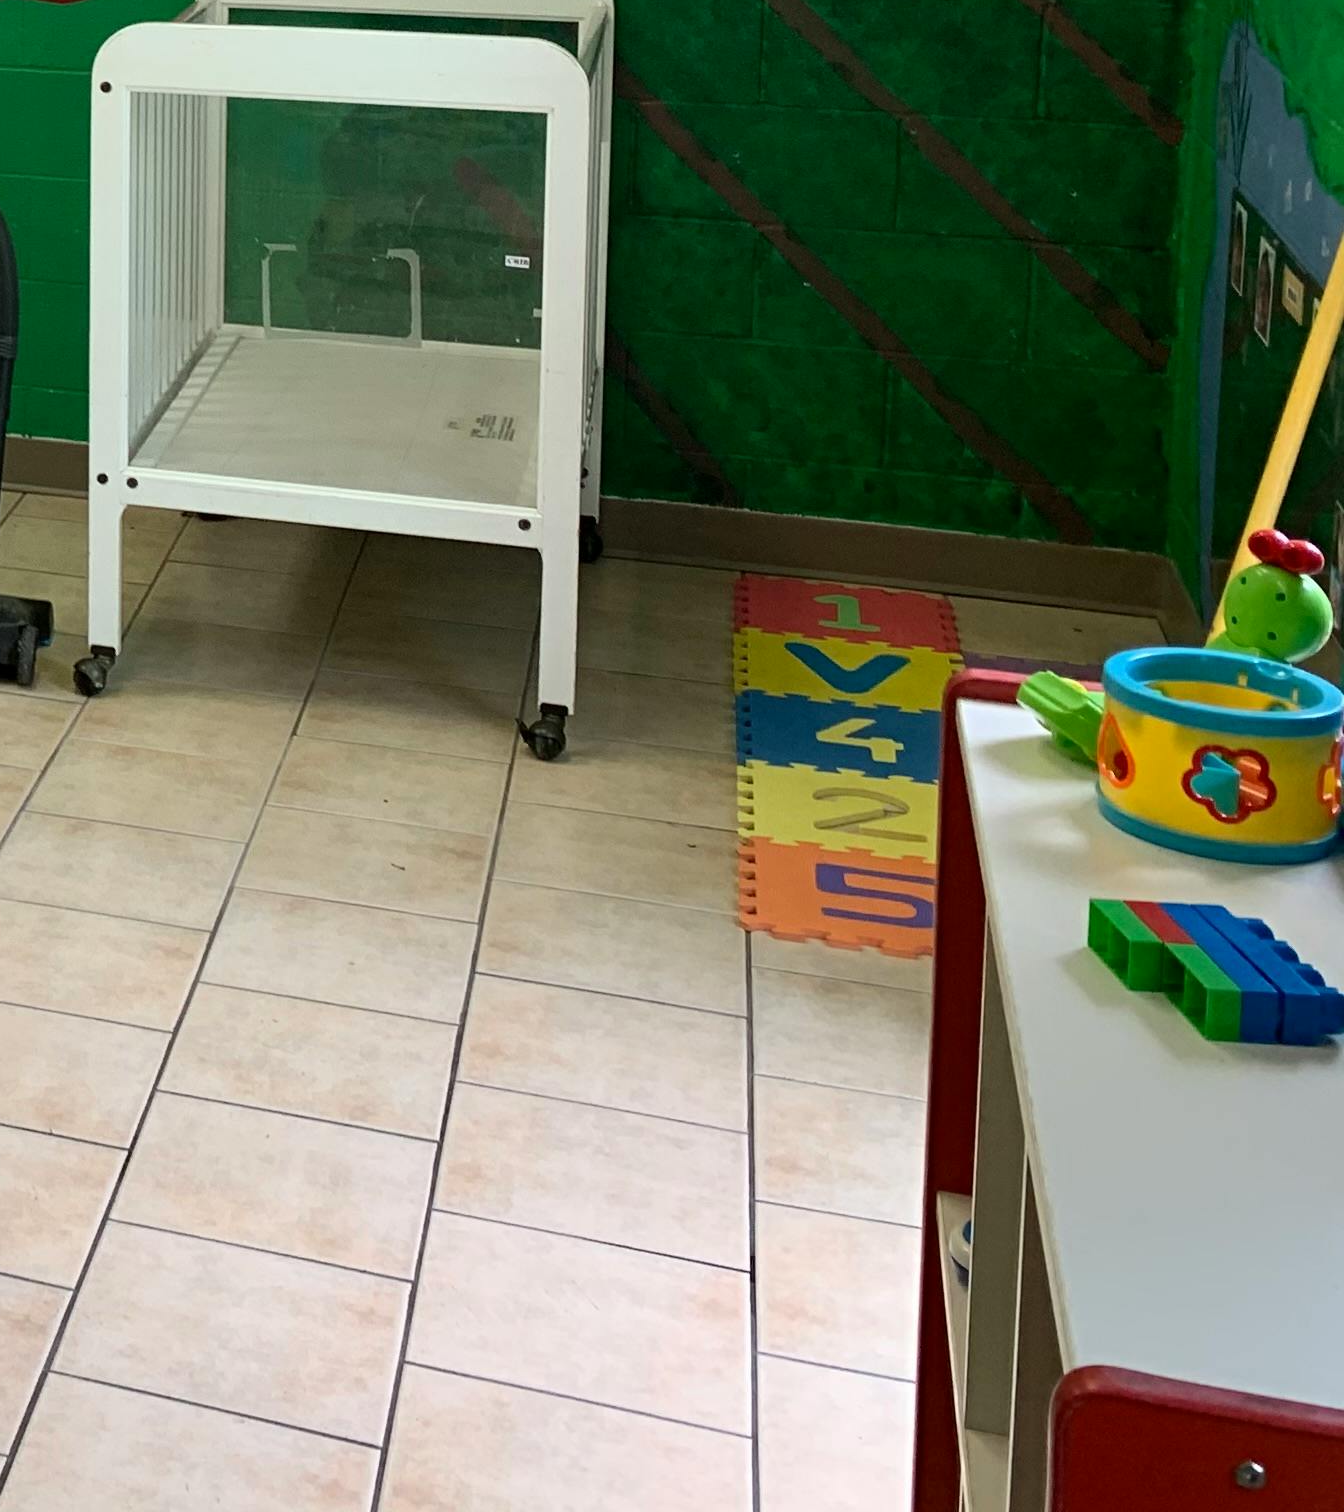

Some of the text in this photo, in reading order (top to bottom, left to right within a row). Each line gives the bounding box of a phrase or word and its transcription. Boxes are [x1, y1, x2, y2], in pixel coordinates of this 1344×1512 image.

[813, 595, 881, 633] 1
[815, 718, 904, 764] 4
[812, 787, 928, 843] 2
[815, 863, 937, 929] 5
